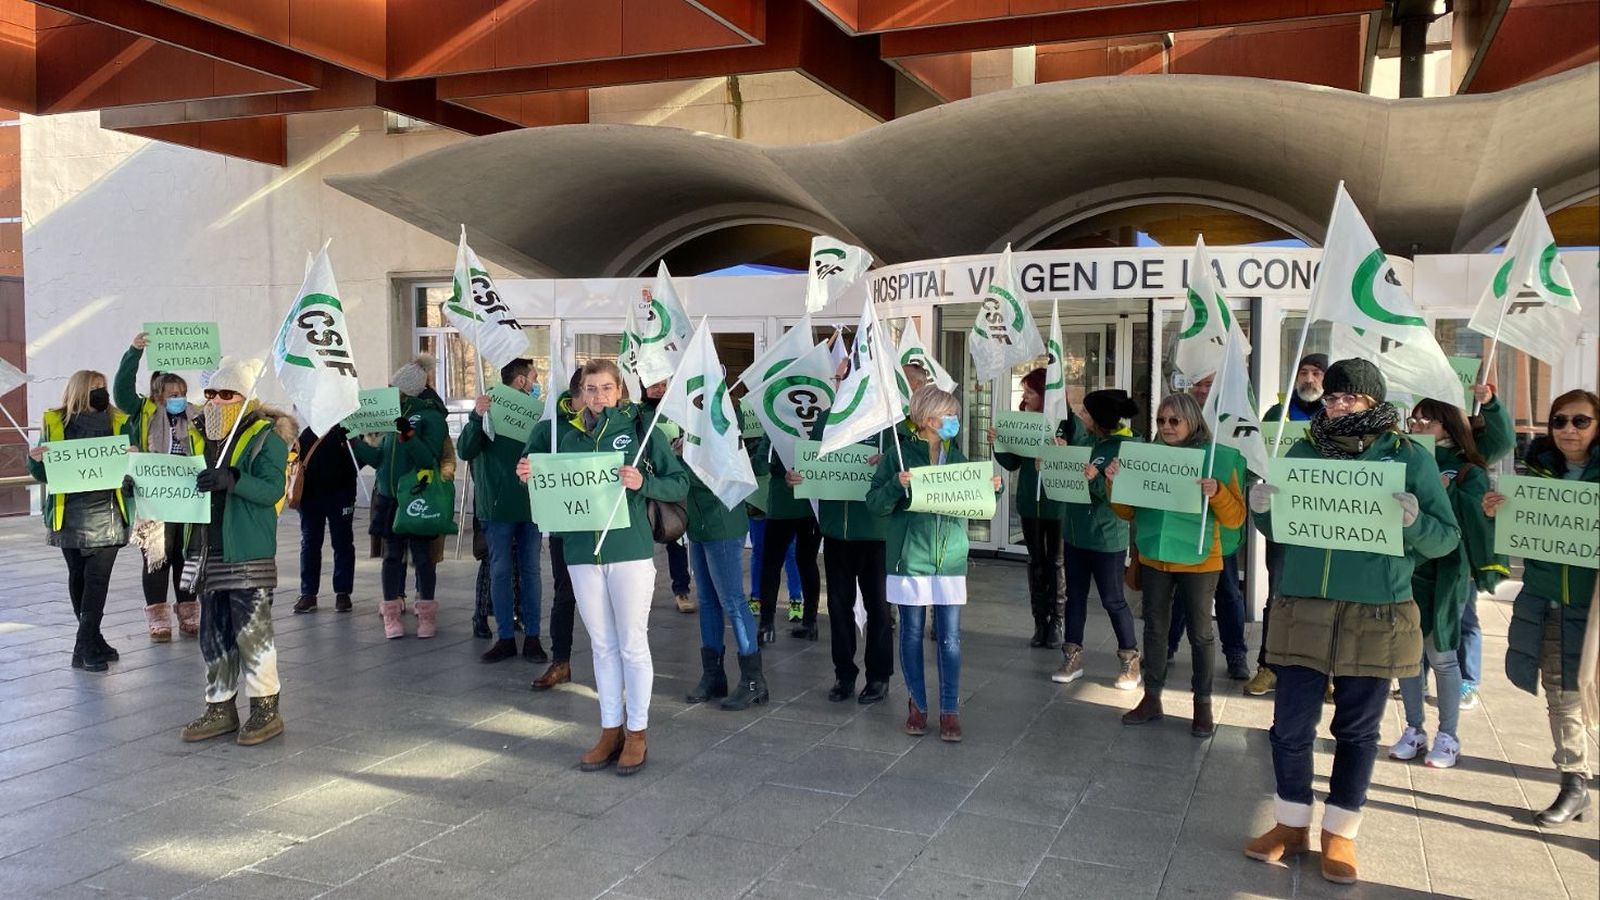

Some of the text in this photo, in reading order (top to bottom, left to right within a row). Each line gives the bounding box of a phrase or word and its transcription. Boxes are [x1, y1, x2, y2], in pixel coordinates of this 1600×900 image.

[873, 269, 954, 304] HOSPITAL
[968, 260, 1098, 297] VIGEN
[1113, 259, 1164, 290] DE
[982, 297, 1013, 346] CSIF
[155, 325, 209, 336] ATENCIÓN
[157, 340, 210, 352] PRIMARIA
[297, 310, 358, 378] CSIF
[156, 356, 213, 367] SATURADA
[503, 414, 527, 430] REAL
[76, 444, 129, 460] HORAS
[78, 467, 103, 481] YA!
[1044, 460, 1084, 473] SANITARIOS
[1119, 457, 1199, 478] NEGOCIACIÓN
[561, 467, 620, 488] HORAS
[922, 467, 982, 486] ATENCIÓN
[1287, 467, 1384, 487] ATENCIÓN
[1143, 479, 1171, 494] REAL
[926, 488, 983, 504] PRIMARIA
[564, 499, 590, 515] YA!
[1291, 494, 1383, 516] PRIMARIA
[1515, 510, 1599, 532] PRIMARIA
[1288, 521, 1387, 545] SATURADA
